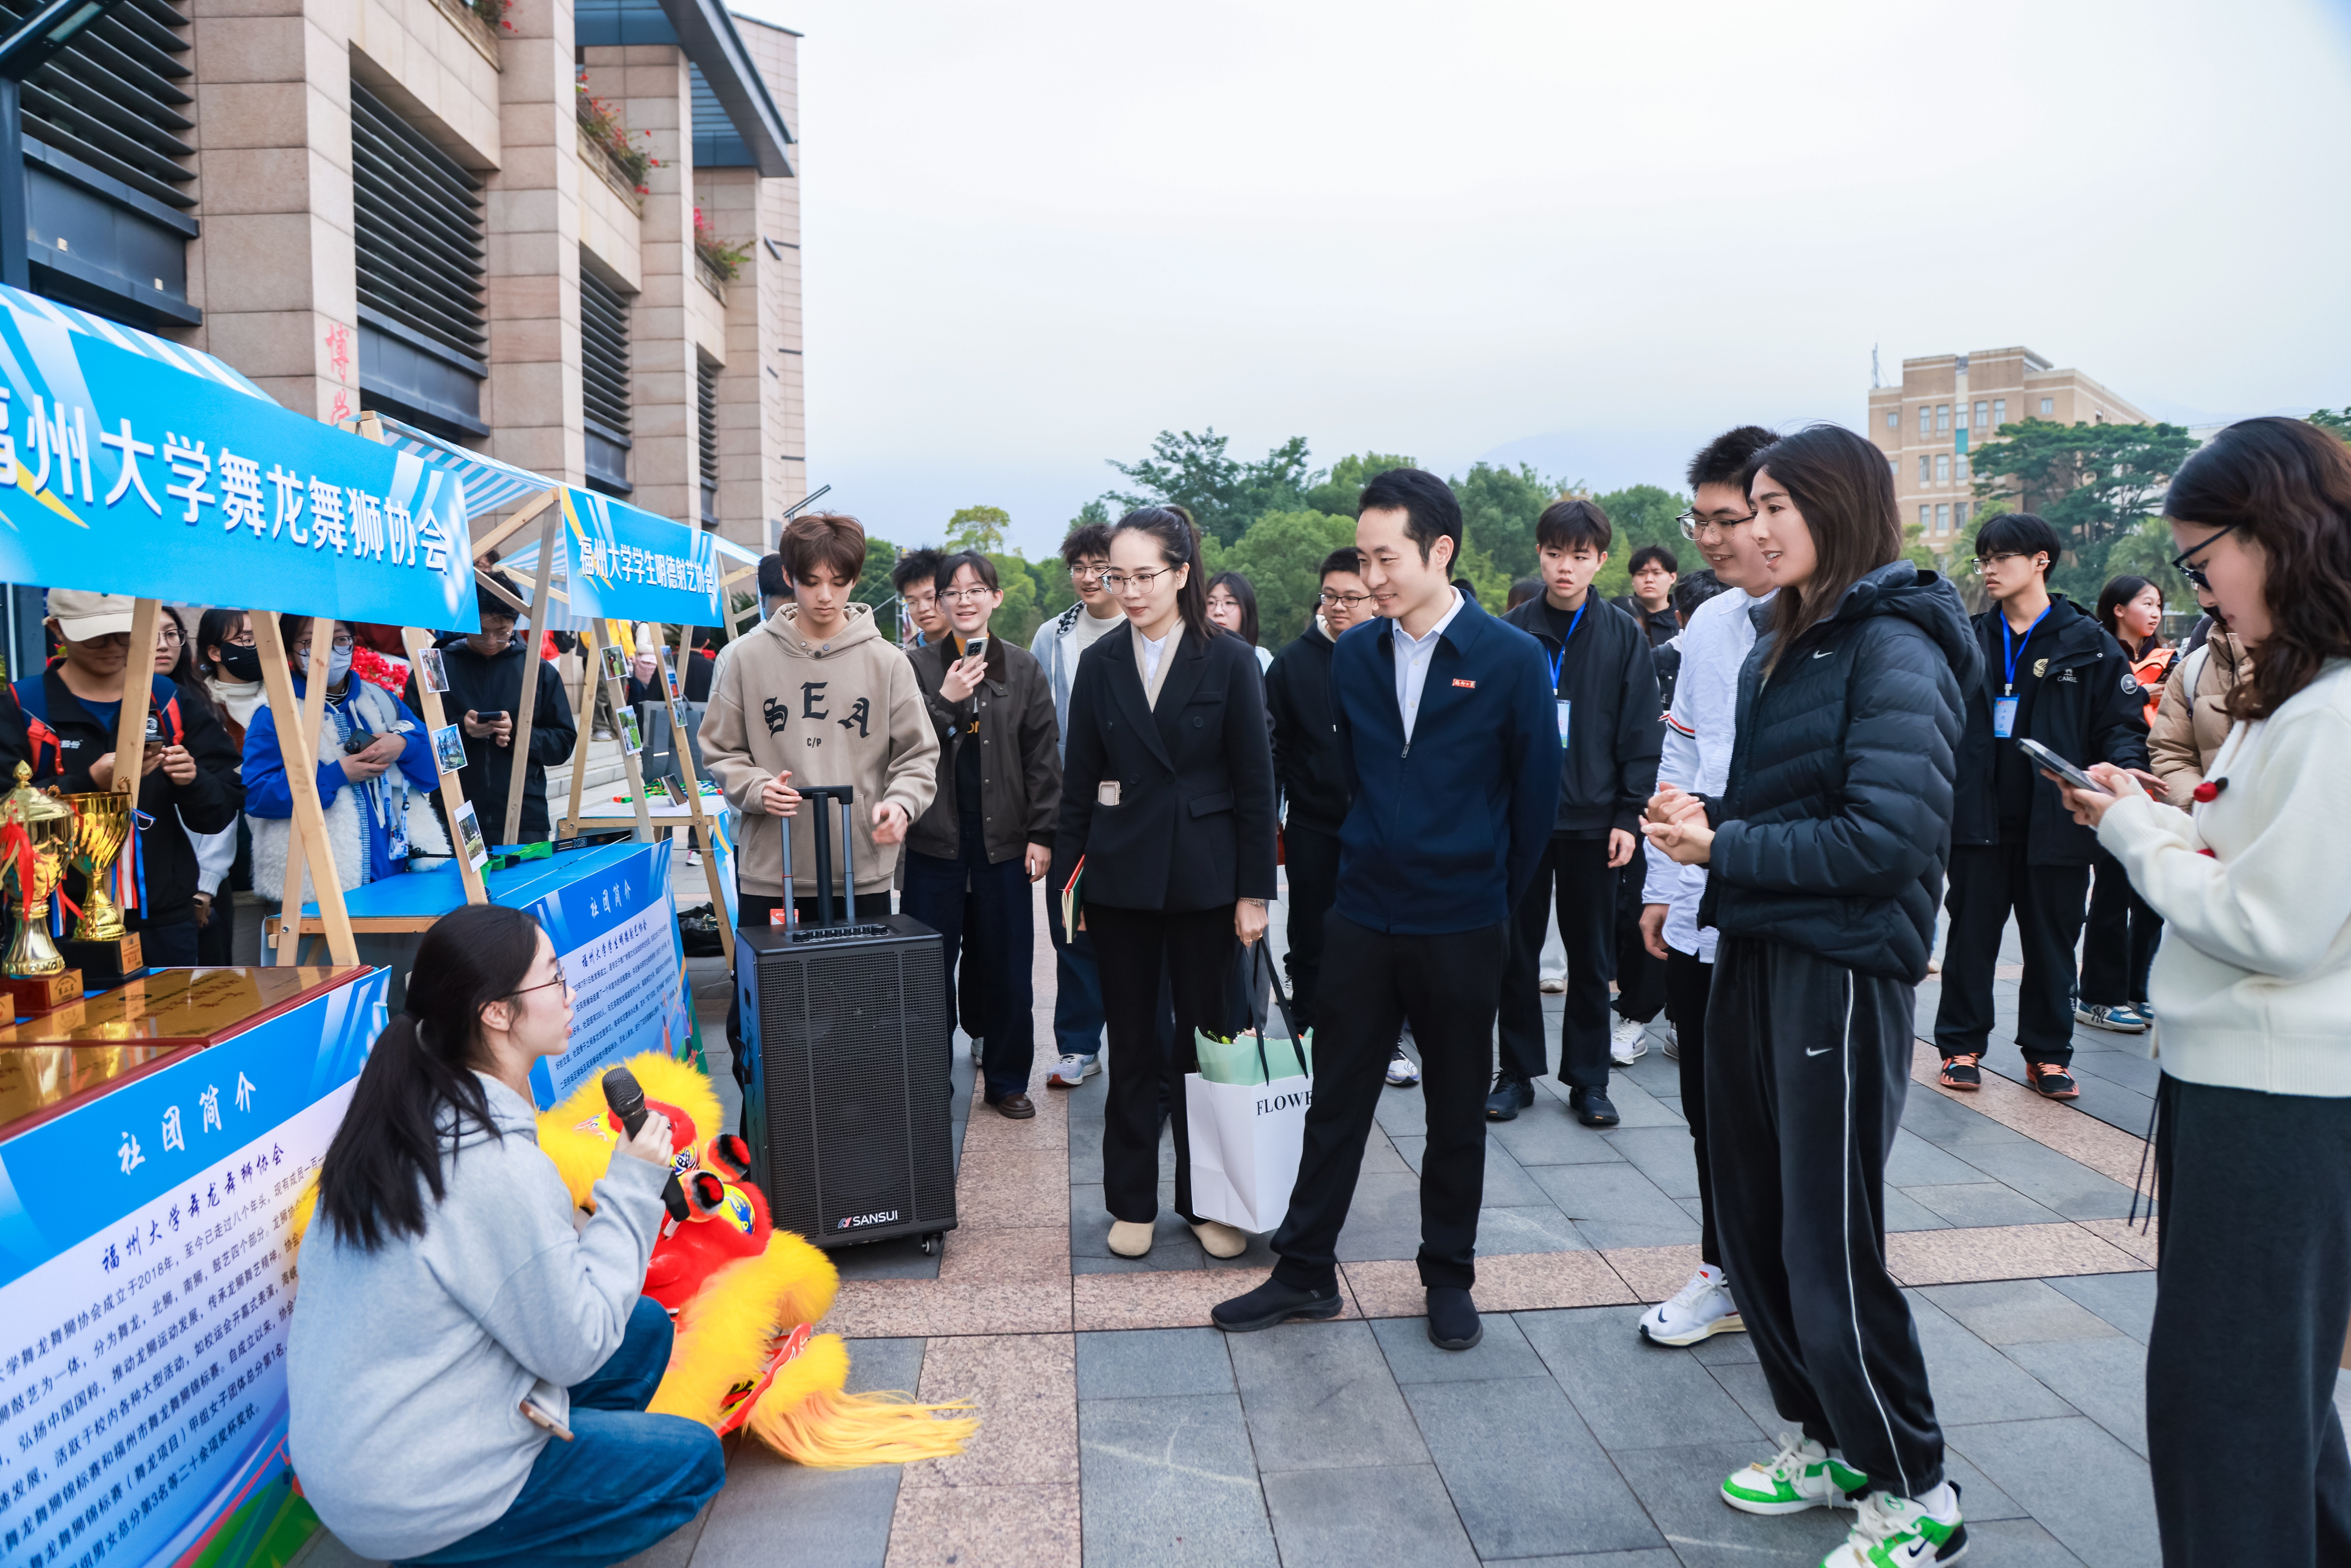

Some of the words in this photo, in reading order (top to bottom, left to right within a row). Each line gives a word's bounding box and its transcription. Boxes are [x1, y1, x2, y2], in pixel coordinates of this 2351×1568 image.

[0, 386, 448, 574] 州大学舞龙舞狮协会
[578, 535, 716, 596] 福州大学学生明德射艺协会
[807, 737, 821, 748] C/P
[590, 879, 631, 919] 社团简介
[118, 1071, 256, 1175] 社团简介
[102, 1142, 284, 1273] 福州大学舞龙舞狮协会
[852, 1209, 898, 1226] SANSUI
[0, 1232, 303, 1466] ，弘扬中国国粹，推动龙狮运动发展，传承龙狮舞艺精神。协会
[0, 1294, 297, 1561] 舞龙舞狮锦标赛和福州市舞龙舞狮锦标赛。自成立以来，协会
